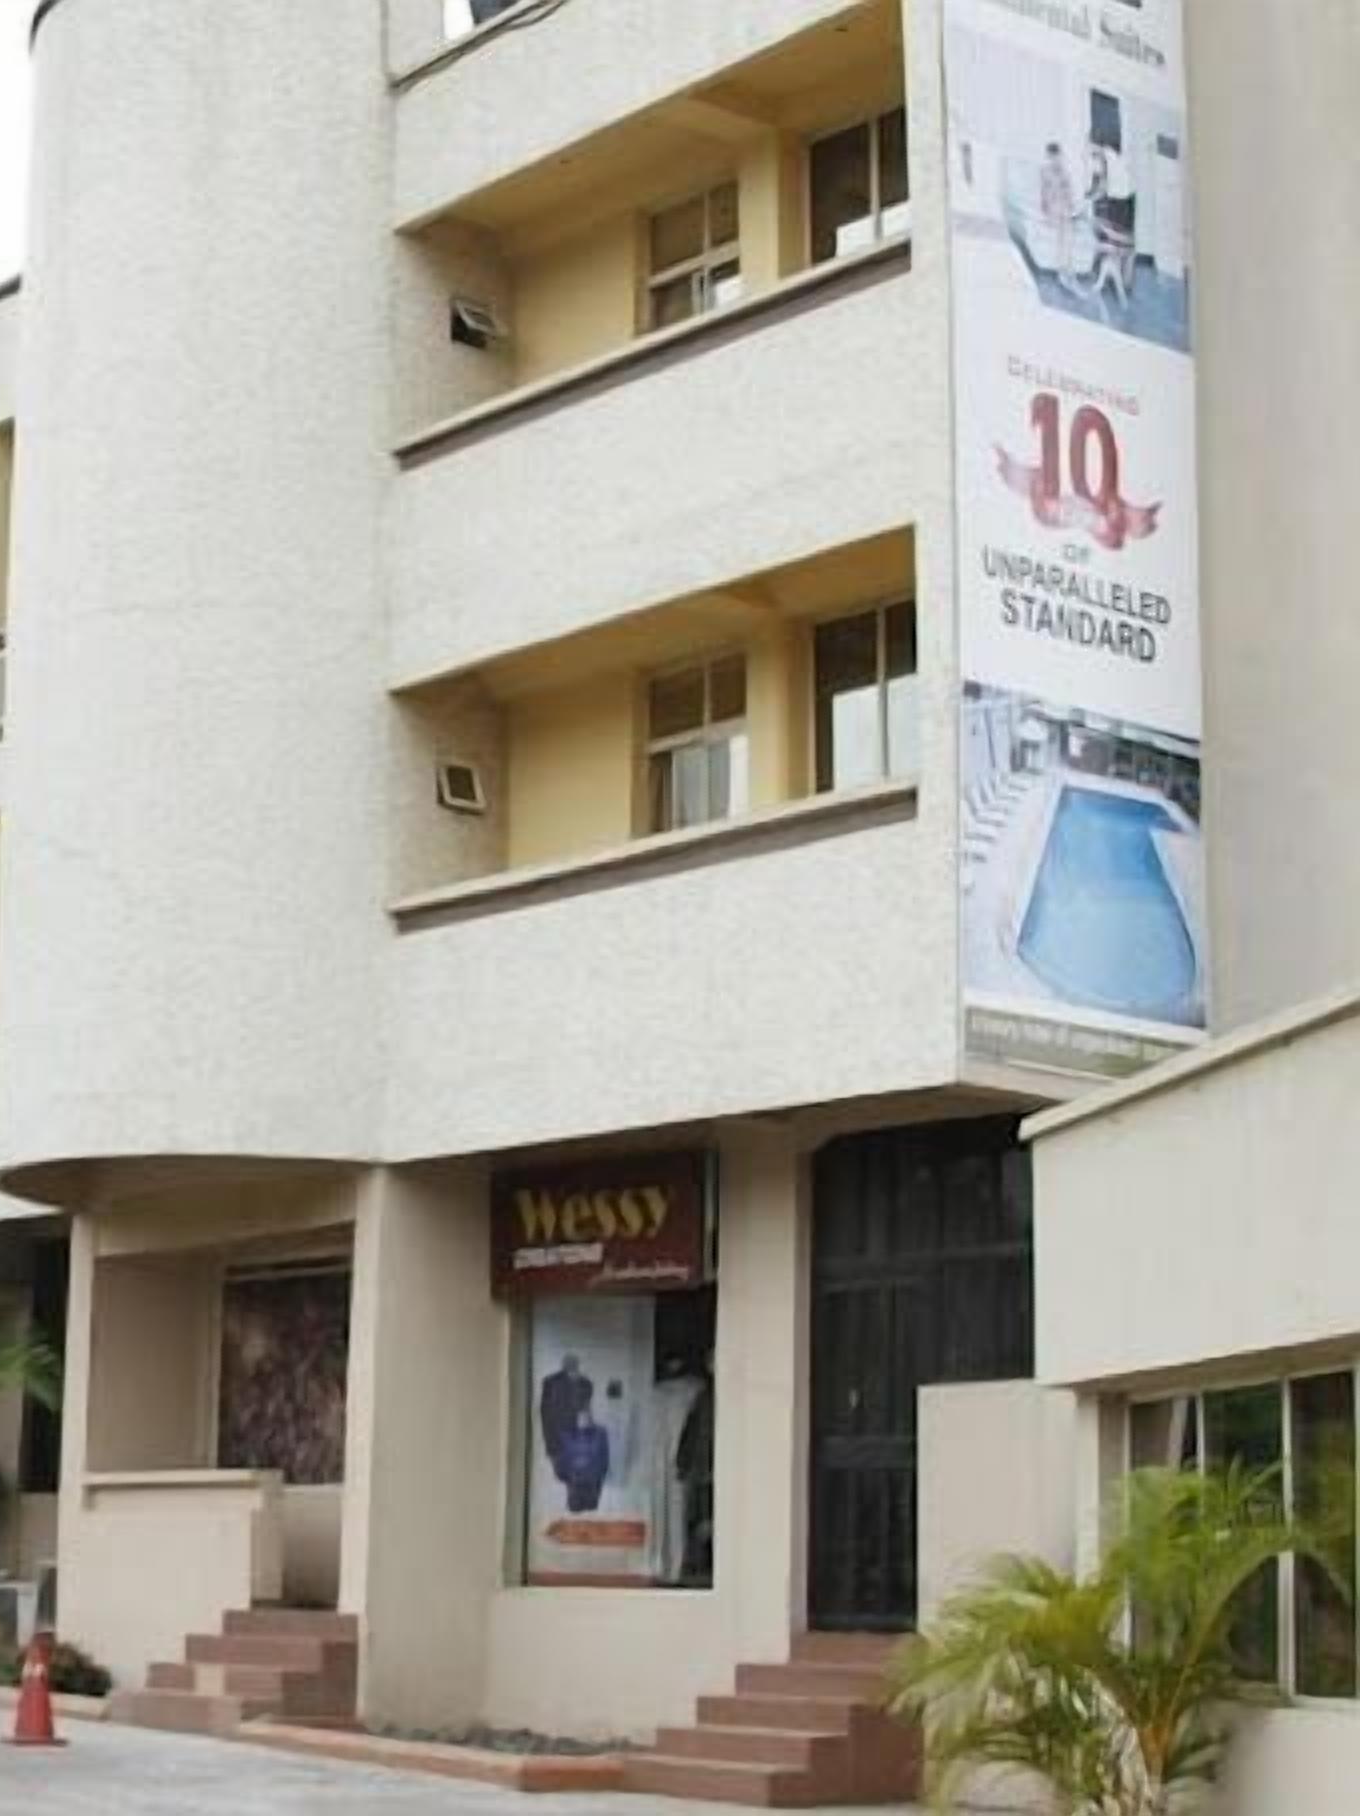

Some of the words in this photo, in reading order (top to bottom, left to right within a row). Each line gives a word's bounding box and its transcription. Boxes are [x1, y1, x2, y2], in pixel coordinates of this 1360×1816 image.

[1030, 391, 1120, 512] 10
[981, 543, 1173, 625] UNPARALLELED
[999, 587, 1158, 663] STANDARD
[514, 1184, 676, 1243] Wessy
